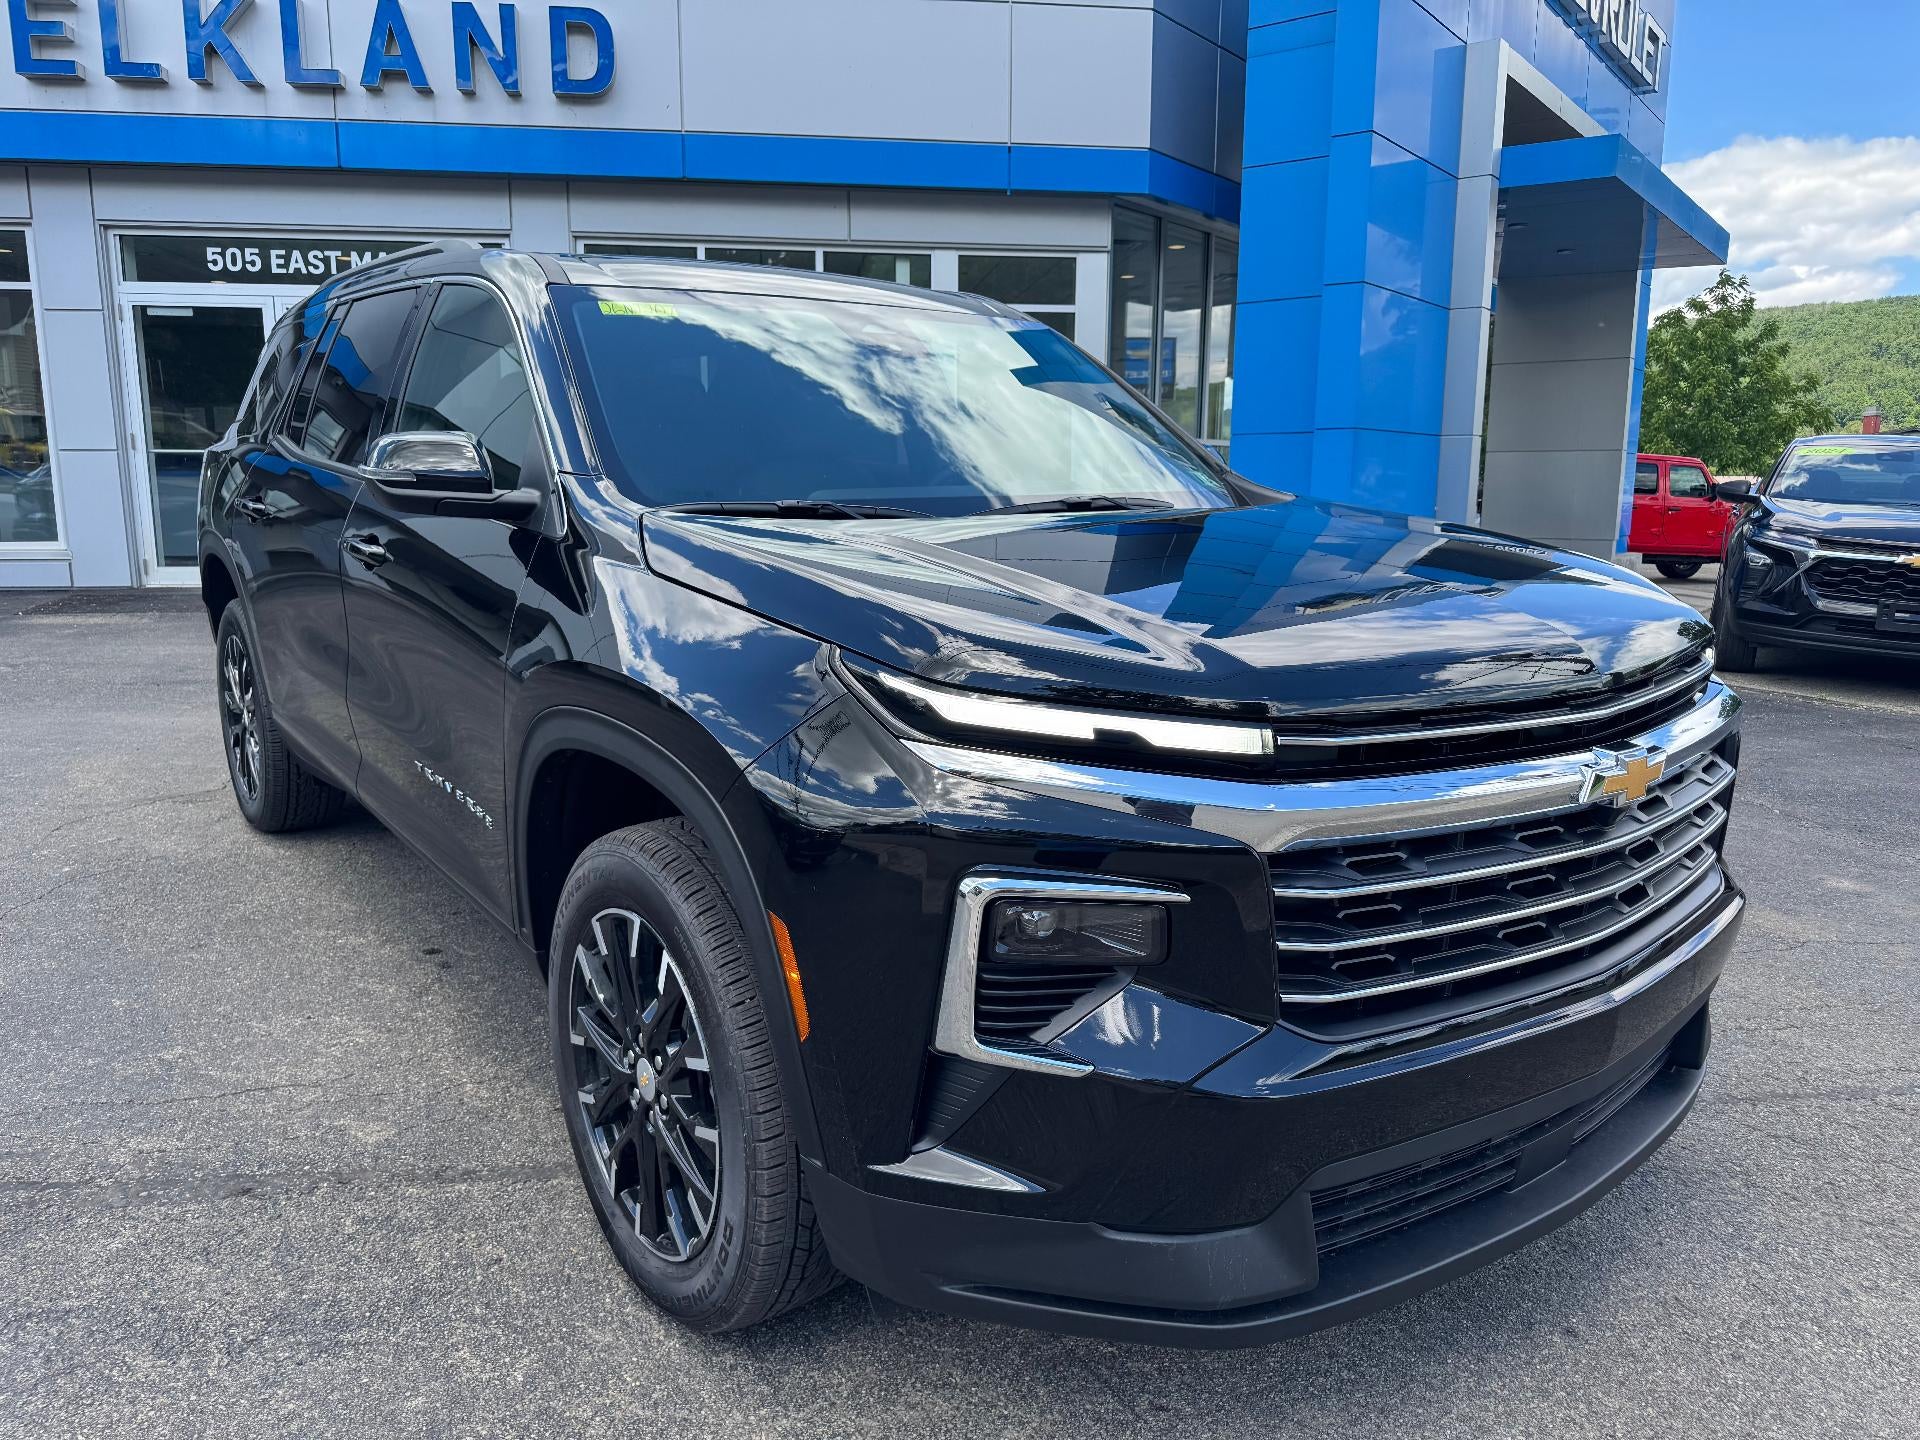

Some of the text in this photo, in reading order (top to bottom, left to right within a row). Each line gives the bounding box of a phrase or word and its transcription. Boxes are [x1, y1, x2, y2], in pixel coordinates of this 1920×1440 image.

[7, 0, 616, 98] ELKLAND
[206, 246, 262, 272] 505
[270, 249, 342, 275] EAST
